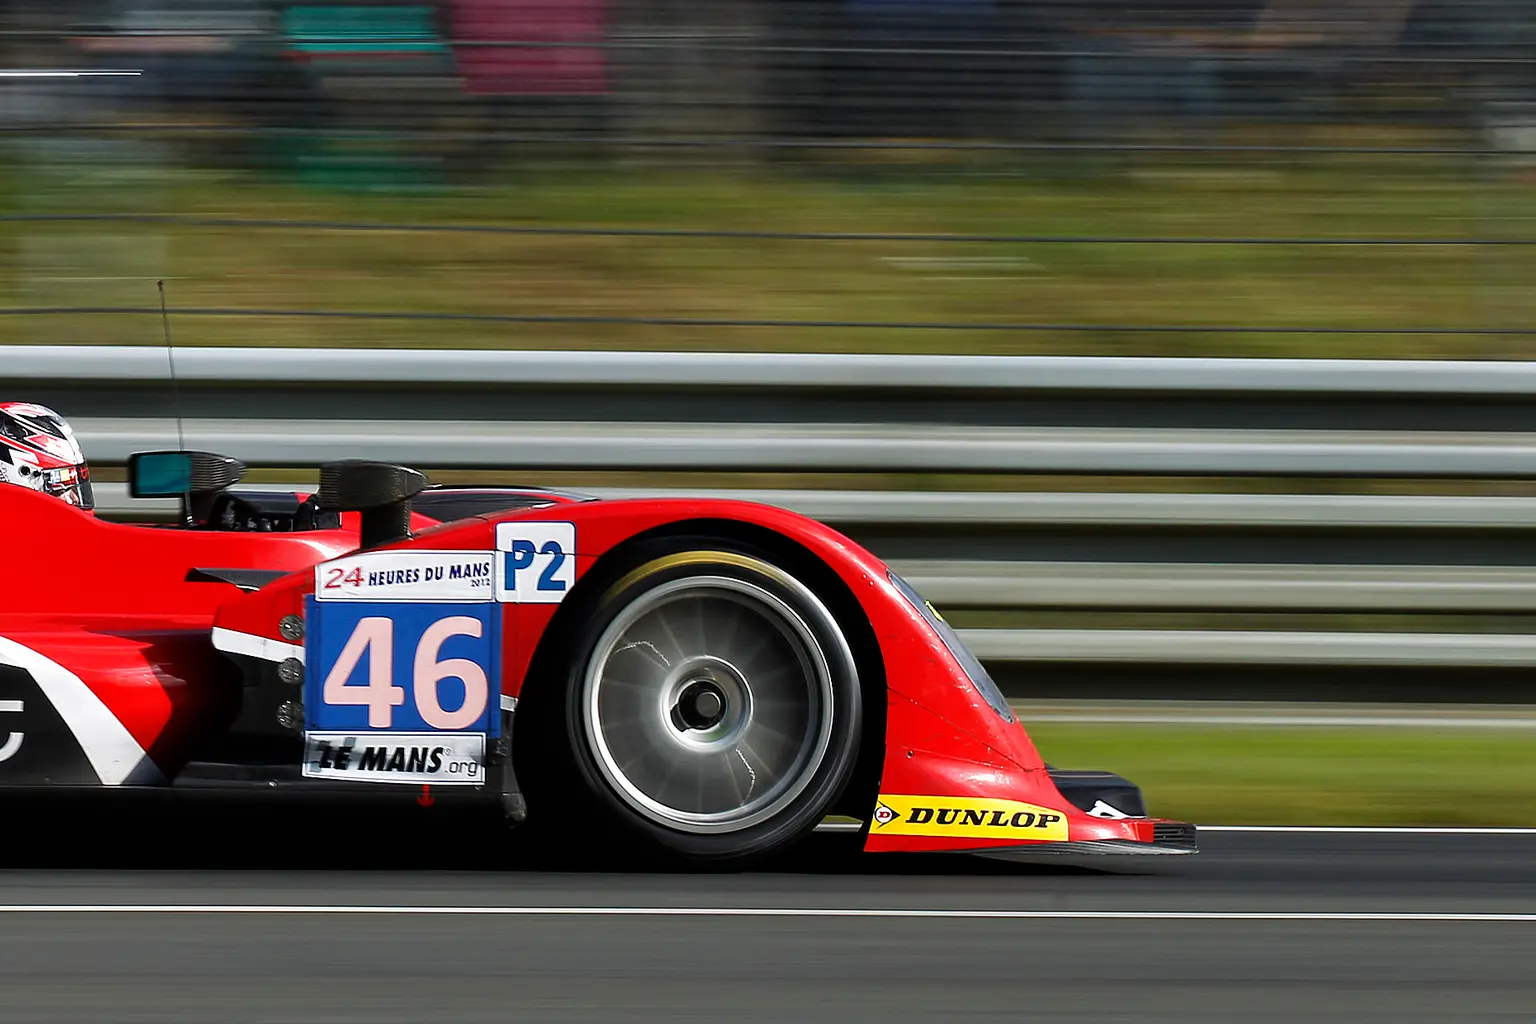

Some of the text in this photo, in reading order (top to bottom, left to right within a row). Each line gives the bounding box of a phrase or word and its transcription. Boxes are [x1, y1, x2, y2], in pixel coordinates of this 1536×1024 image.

[324, 561, 490, 589] 24 HEURES DU MANS
[504, 539, 567, 592] P2
[322, 616, 489, 730] 46
[357, 746, 444, 774] MANS
[905, 807, 1061, 829] DUNLOP
